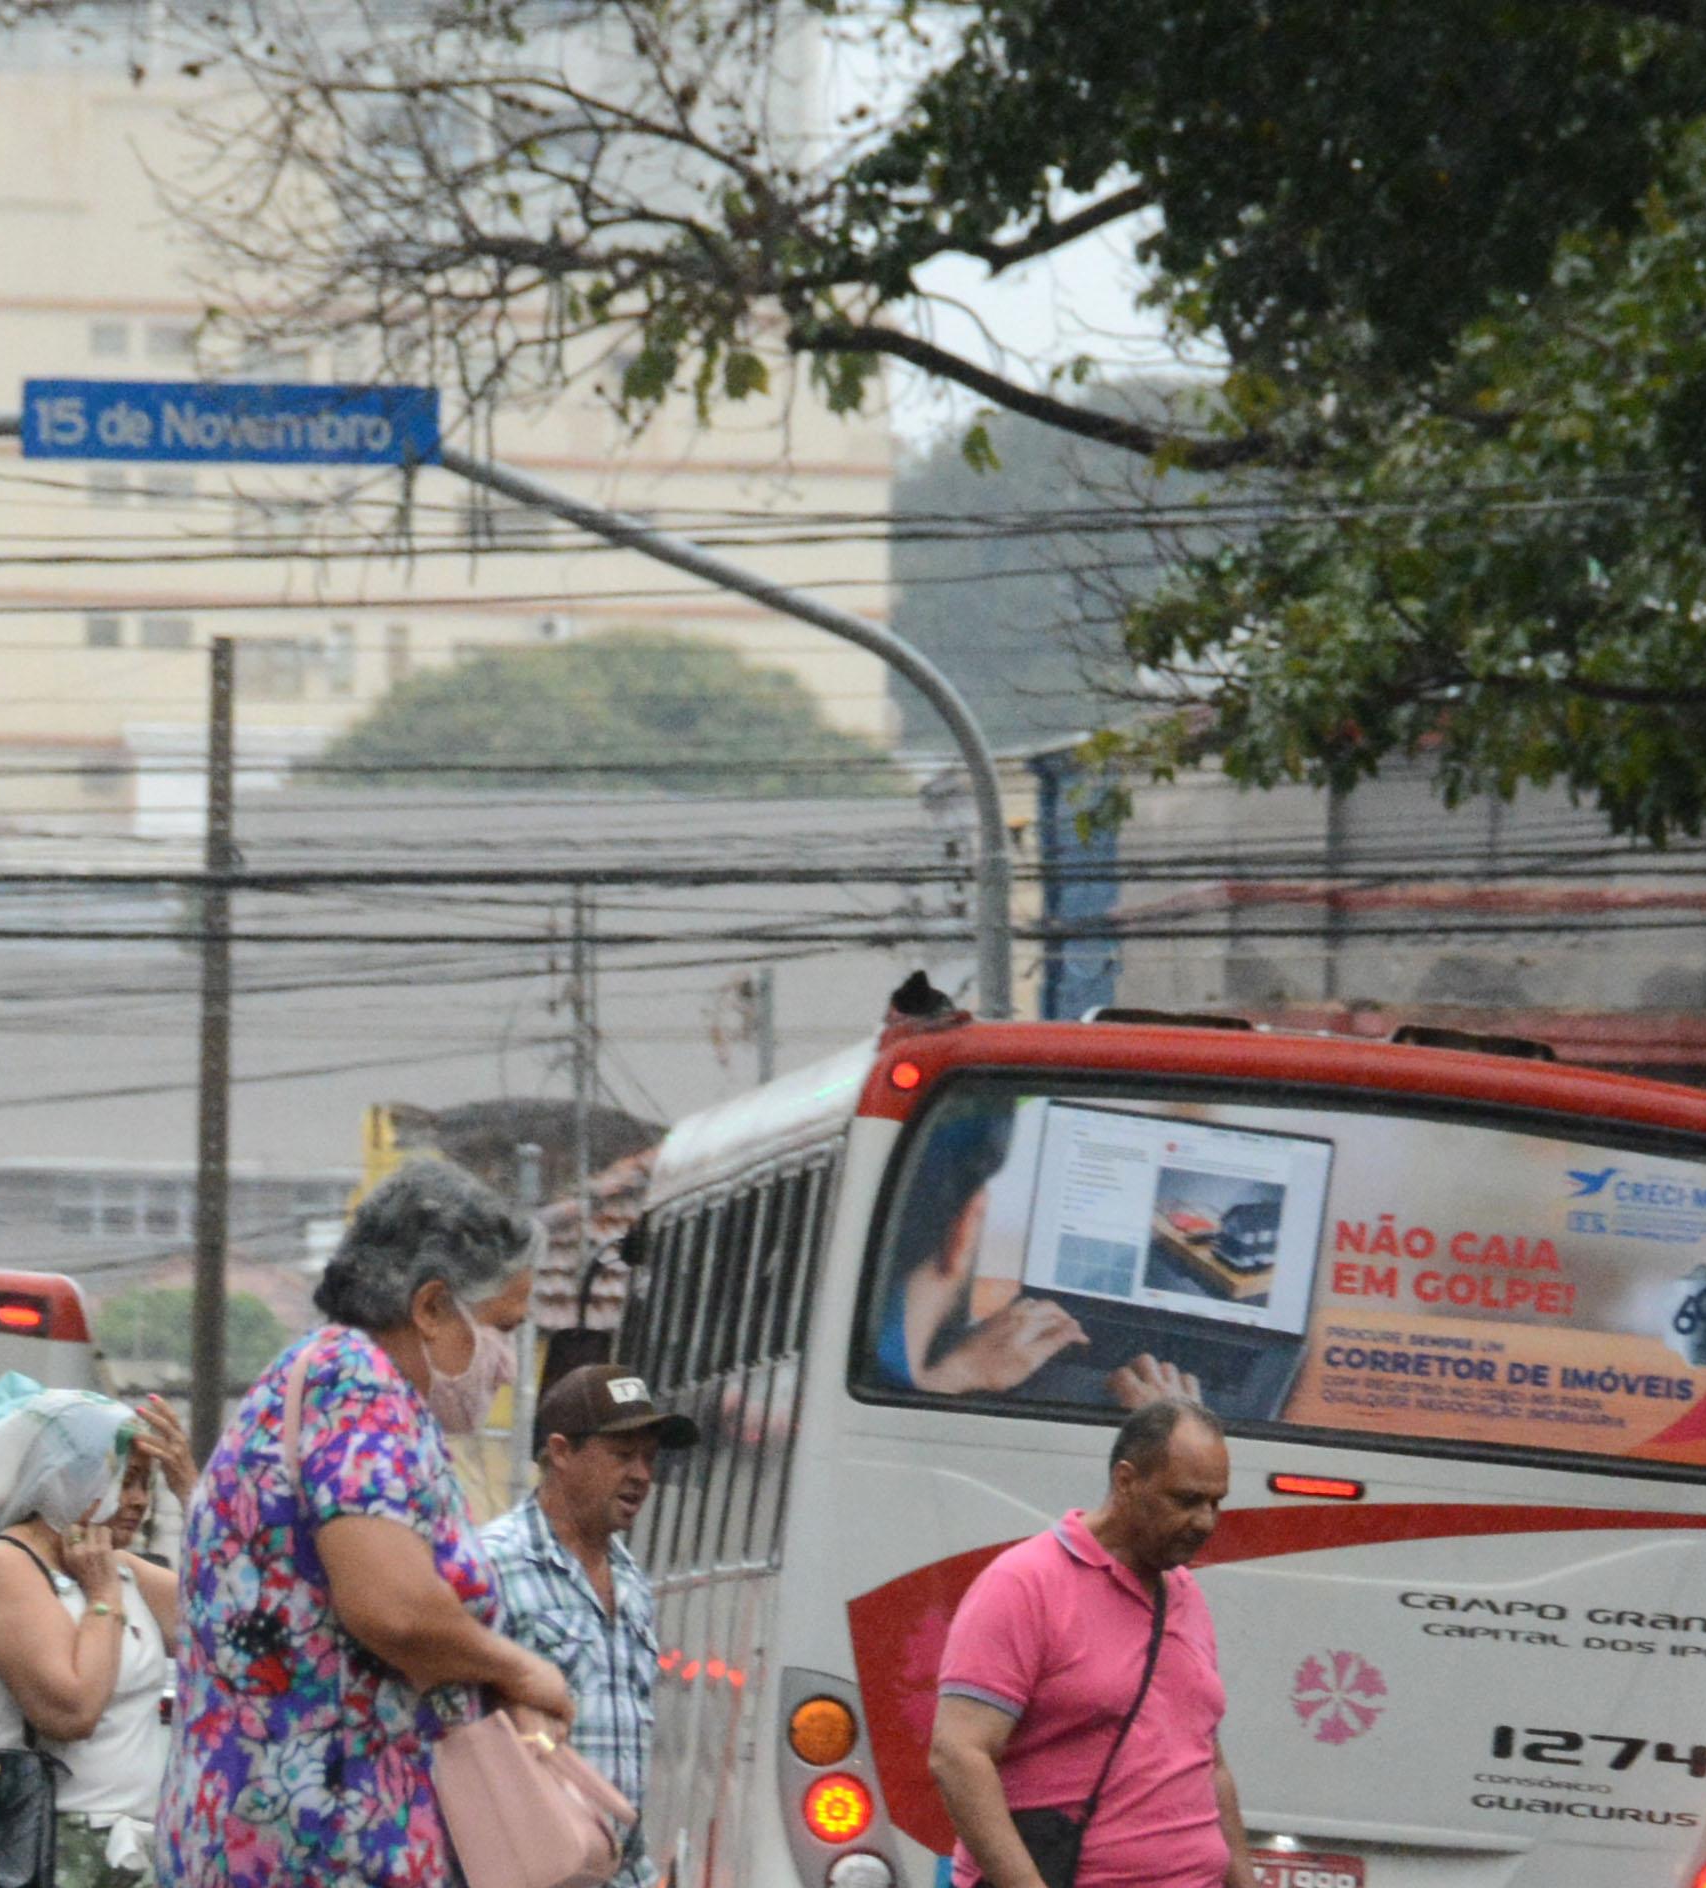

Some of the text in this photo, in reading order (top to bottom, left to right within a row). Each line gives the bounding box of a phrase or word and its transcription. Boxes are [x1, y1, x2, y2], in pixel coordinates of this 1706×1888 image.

[34, 397, 393, 452] 15 de Novembro
[1336, 1213, 1561, 1273] NÃO CAIA
[1333, 1261, 1576, 1316] EM GOLPE!
[1325, 1346, 1694, 1401] CORRETOR DE IMÓVEIS
[1398, 1590, 1568, 1622] CAMPO
[1421, 1621, 1571, 1648] CAPITAL
[1582, 1635, 1657, 1655] DOS
[1473, 1771, 1614, 1795] CONSÓRCIO
[1470, 1792, 1702, 1828] GUAICURUS
